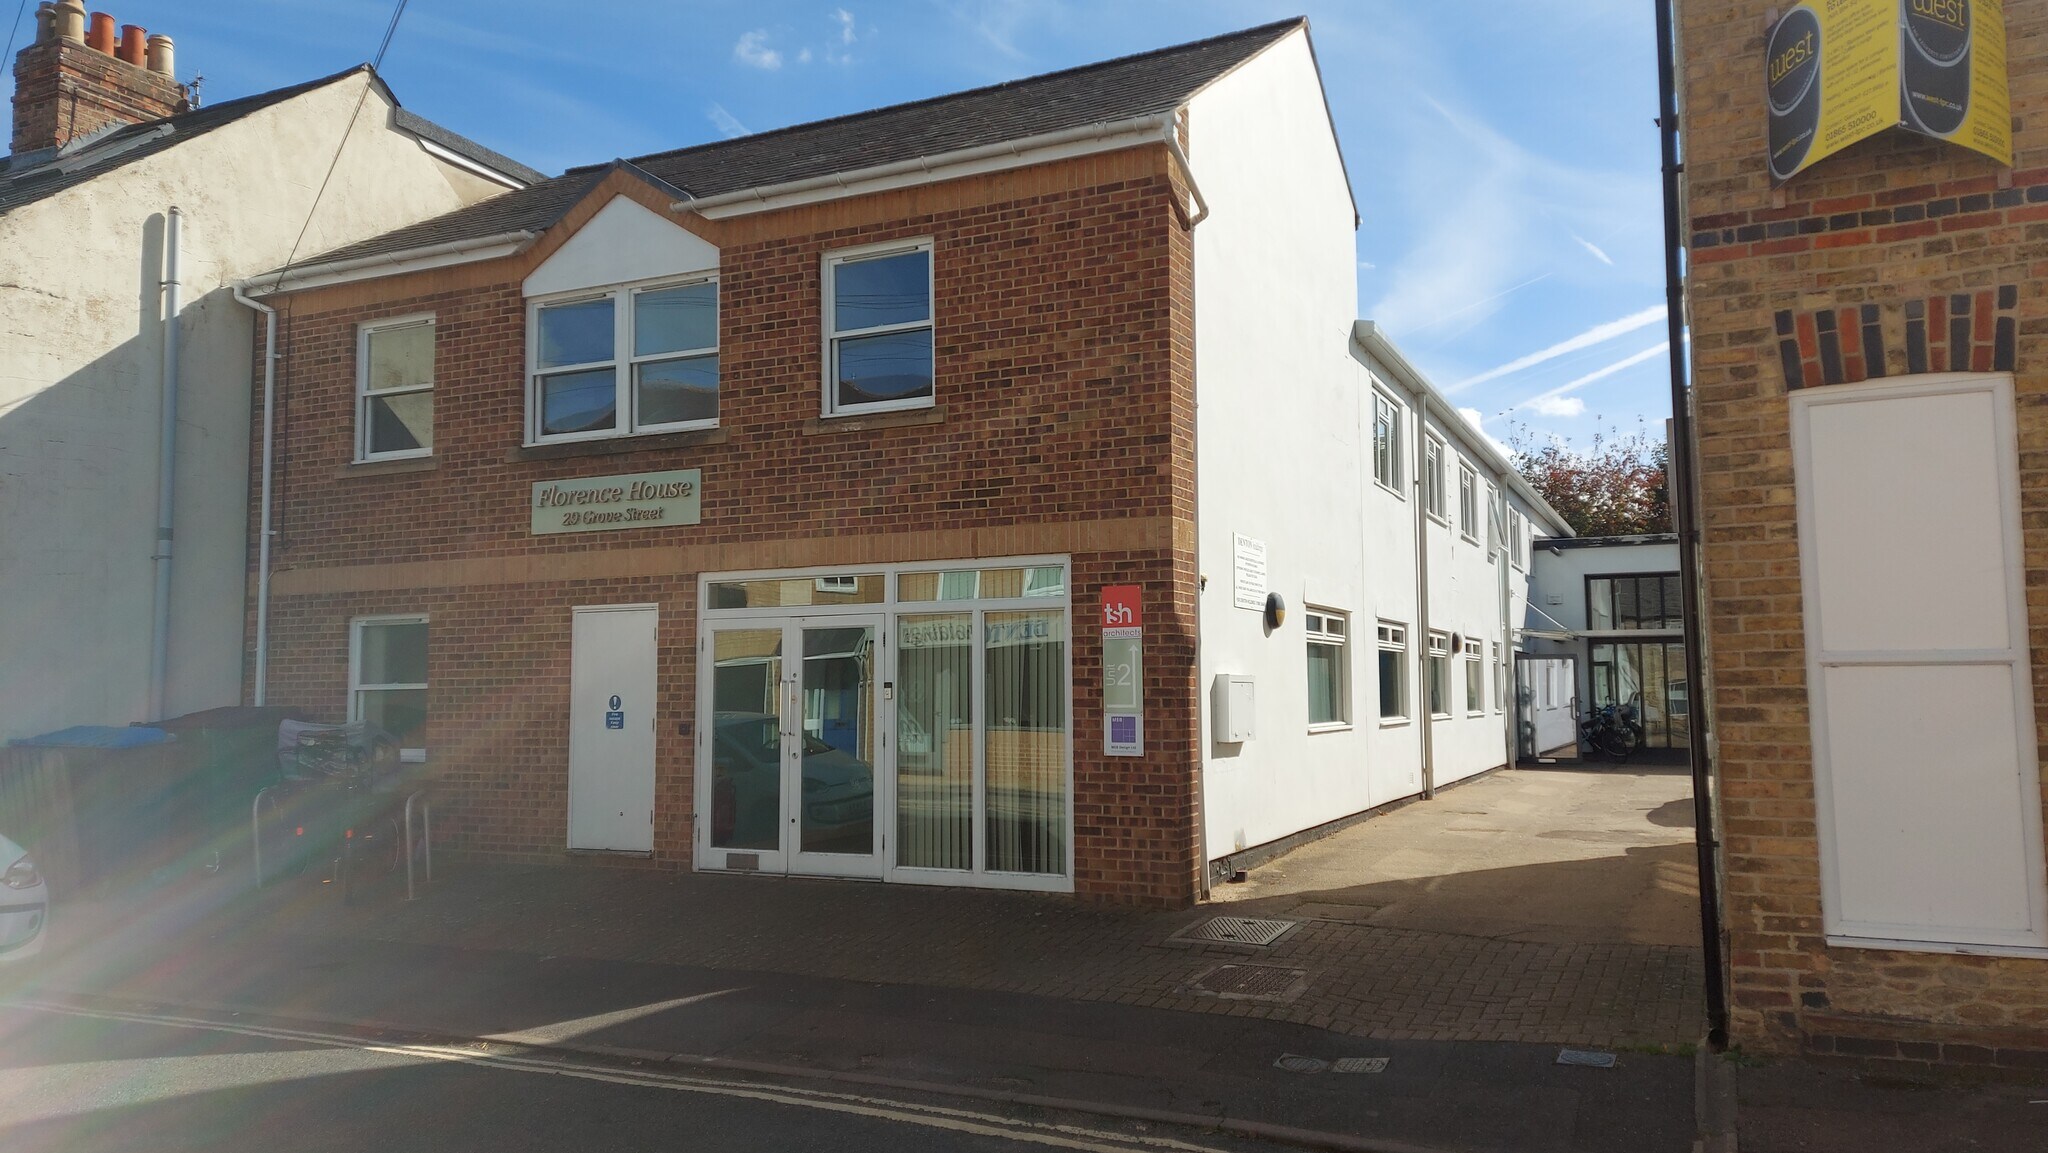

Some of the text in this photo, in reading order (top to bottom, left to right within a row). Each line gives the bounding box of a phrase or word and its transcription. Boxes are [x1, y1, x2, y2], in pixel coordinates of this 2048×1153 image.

[1770, 30, 1814, 81] west
[1825, 124, 1846, 141] 01865
[536, 480, 693, 507] Florence House
[562, 506, 664, 526] 29 Grove Street
[1104, 602, 1132, 624] tsh
[1103, 629, 1141, 638] architects
[1117, 663, 1131, 686] 2
